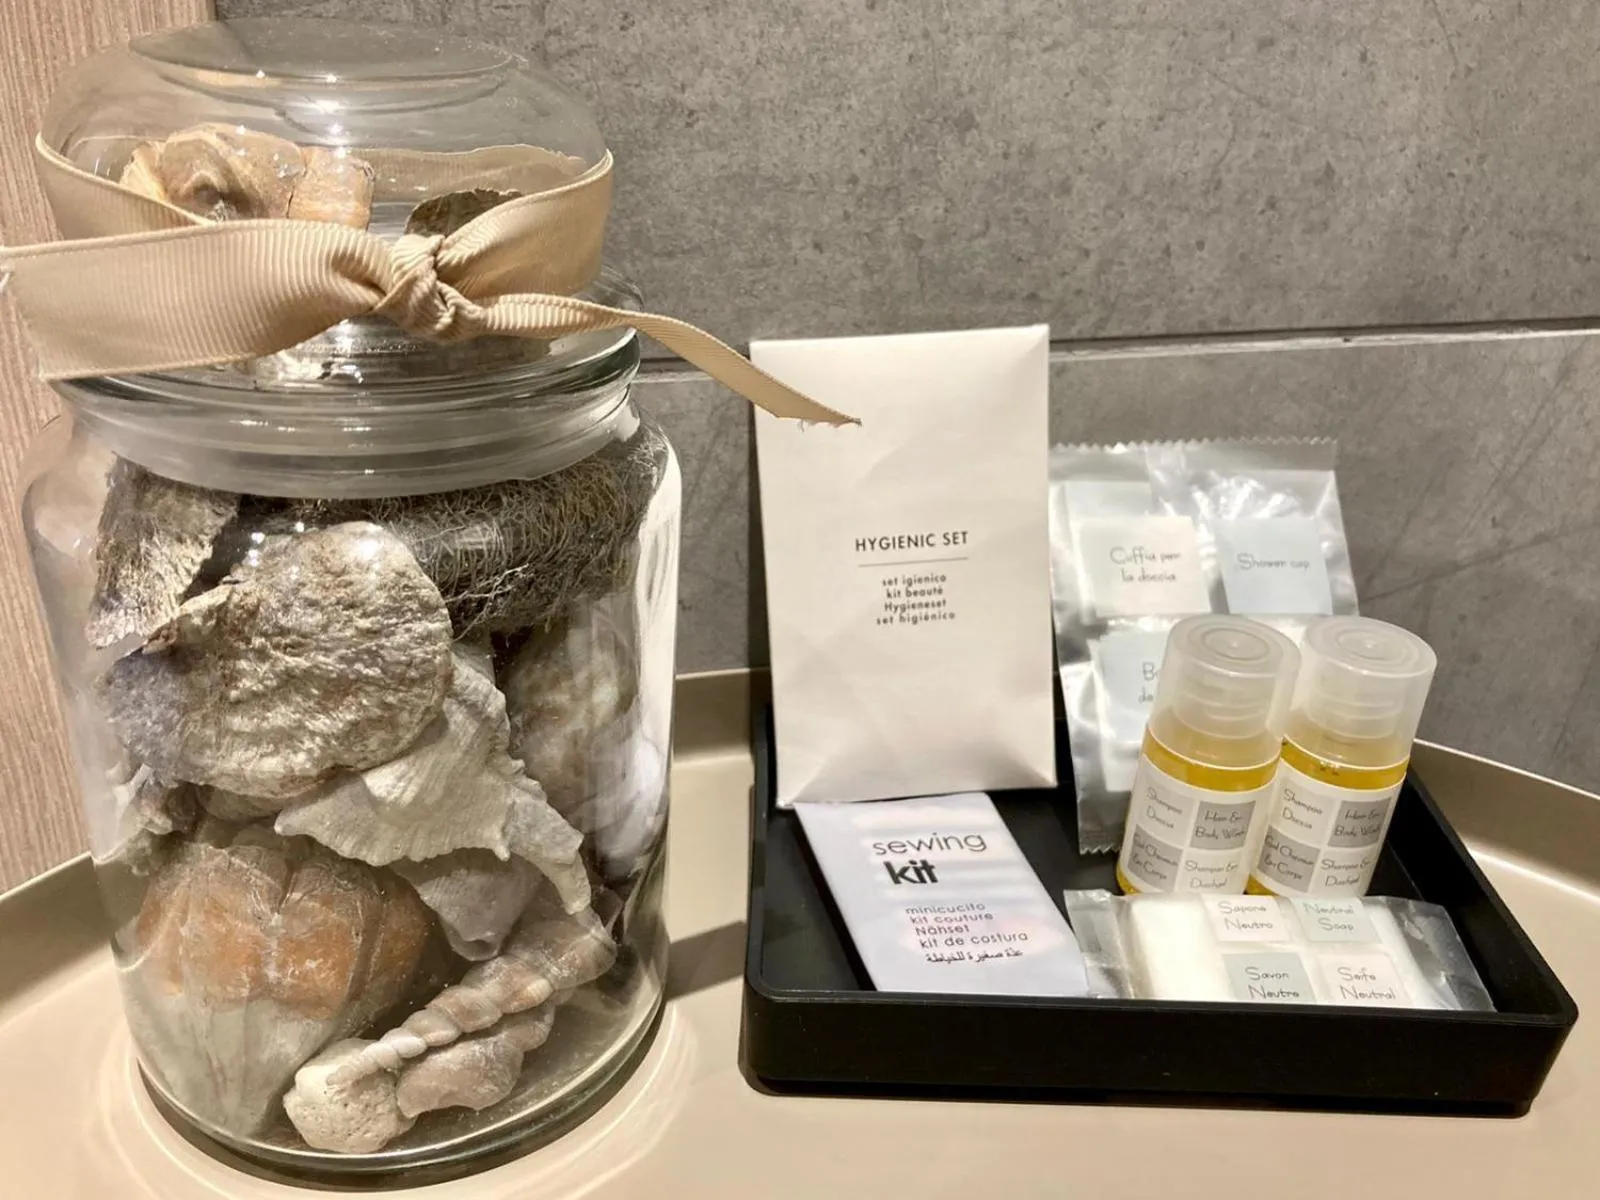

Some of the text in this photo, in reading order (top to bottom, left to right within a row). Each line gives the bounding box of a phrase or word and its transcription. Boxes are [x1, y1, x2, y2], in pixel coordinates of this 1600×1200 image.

[855, 531, 968, 552] HYGIENIC SET
[1237, 552, 1311, 571] Shower cap
[882, 573, 947, 588] set igienico
[886, 585, 944, 599] kit beauté
[884, 599, 947, 614] Hygieneset
[876, 611, 956, 626] set higiénico
[1283, 788, 1323, 815] Shampoo
[872, 832, 987, 856] sewing
[884, 859, 939, 885] kit
[905, 902, 986, 916] minicucito
[1217, 901, 1267, 914] Sapone
[1303, 901, 1355, 915] Neutral
[909, 911, 994, 924] kit couture
[1224, 917, 1274, 931] Neutro
[1318, 917, 1355, 932] Soap
[919, 930, 1029, 950] kit de costura
[1245, 966, 1289, 981] Savon
[1337, 966, 1377, 982] Seife
[1247, 985, 1300, 999] Neutre
[1339, 985, 1397, 1001] Neutral
